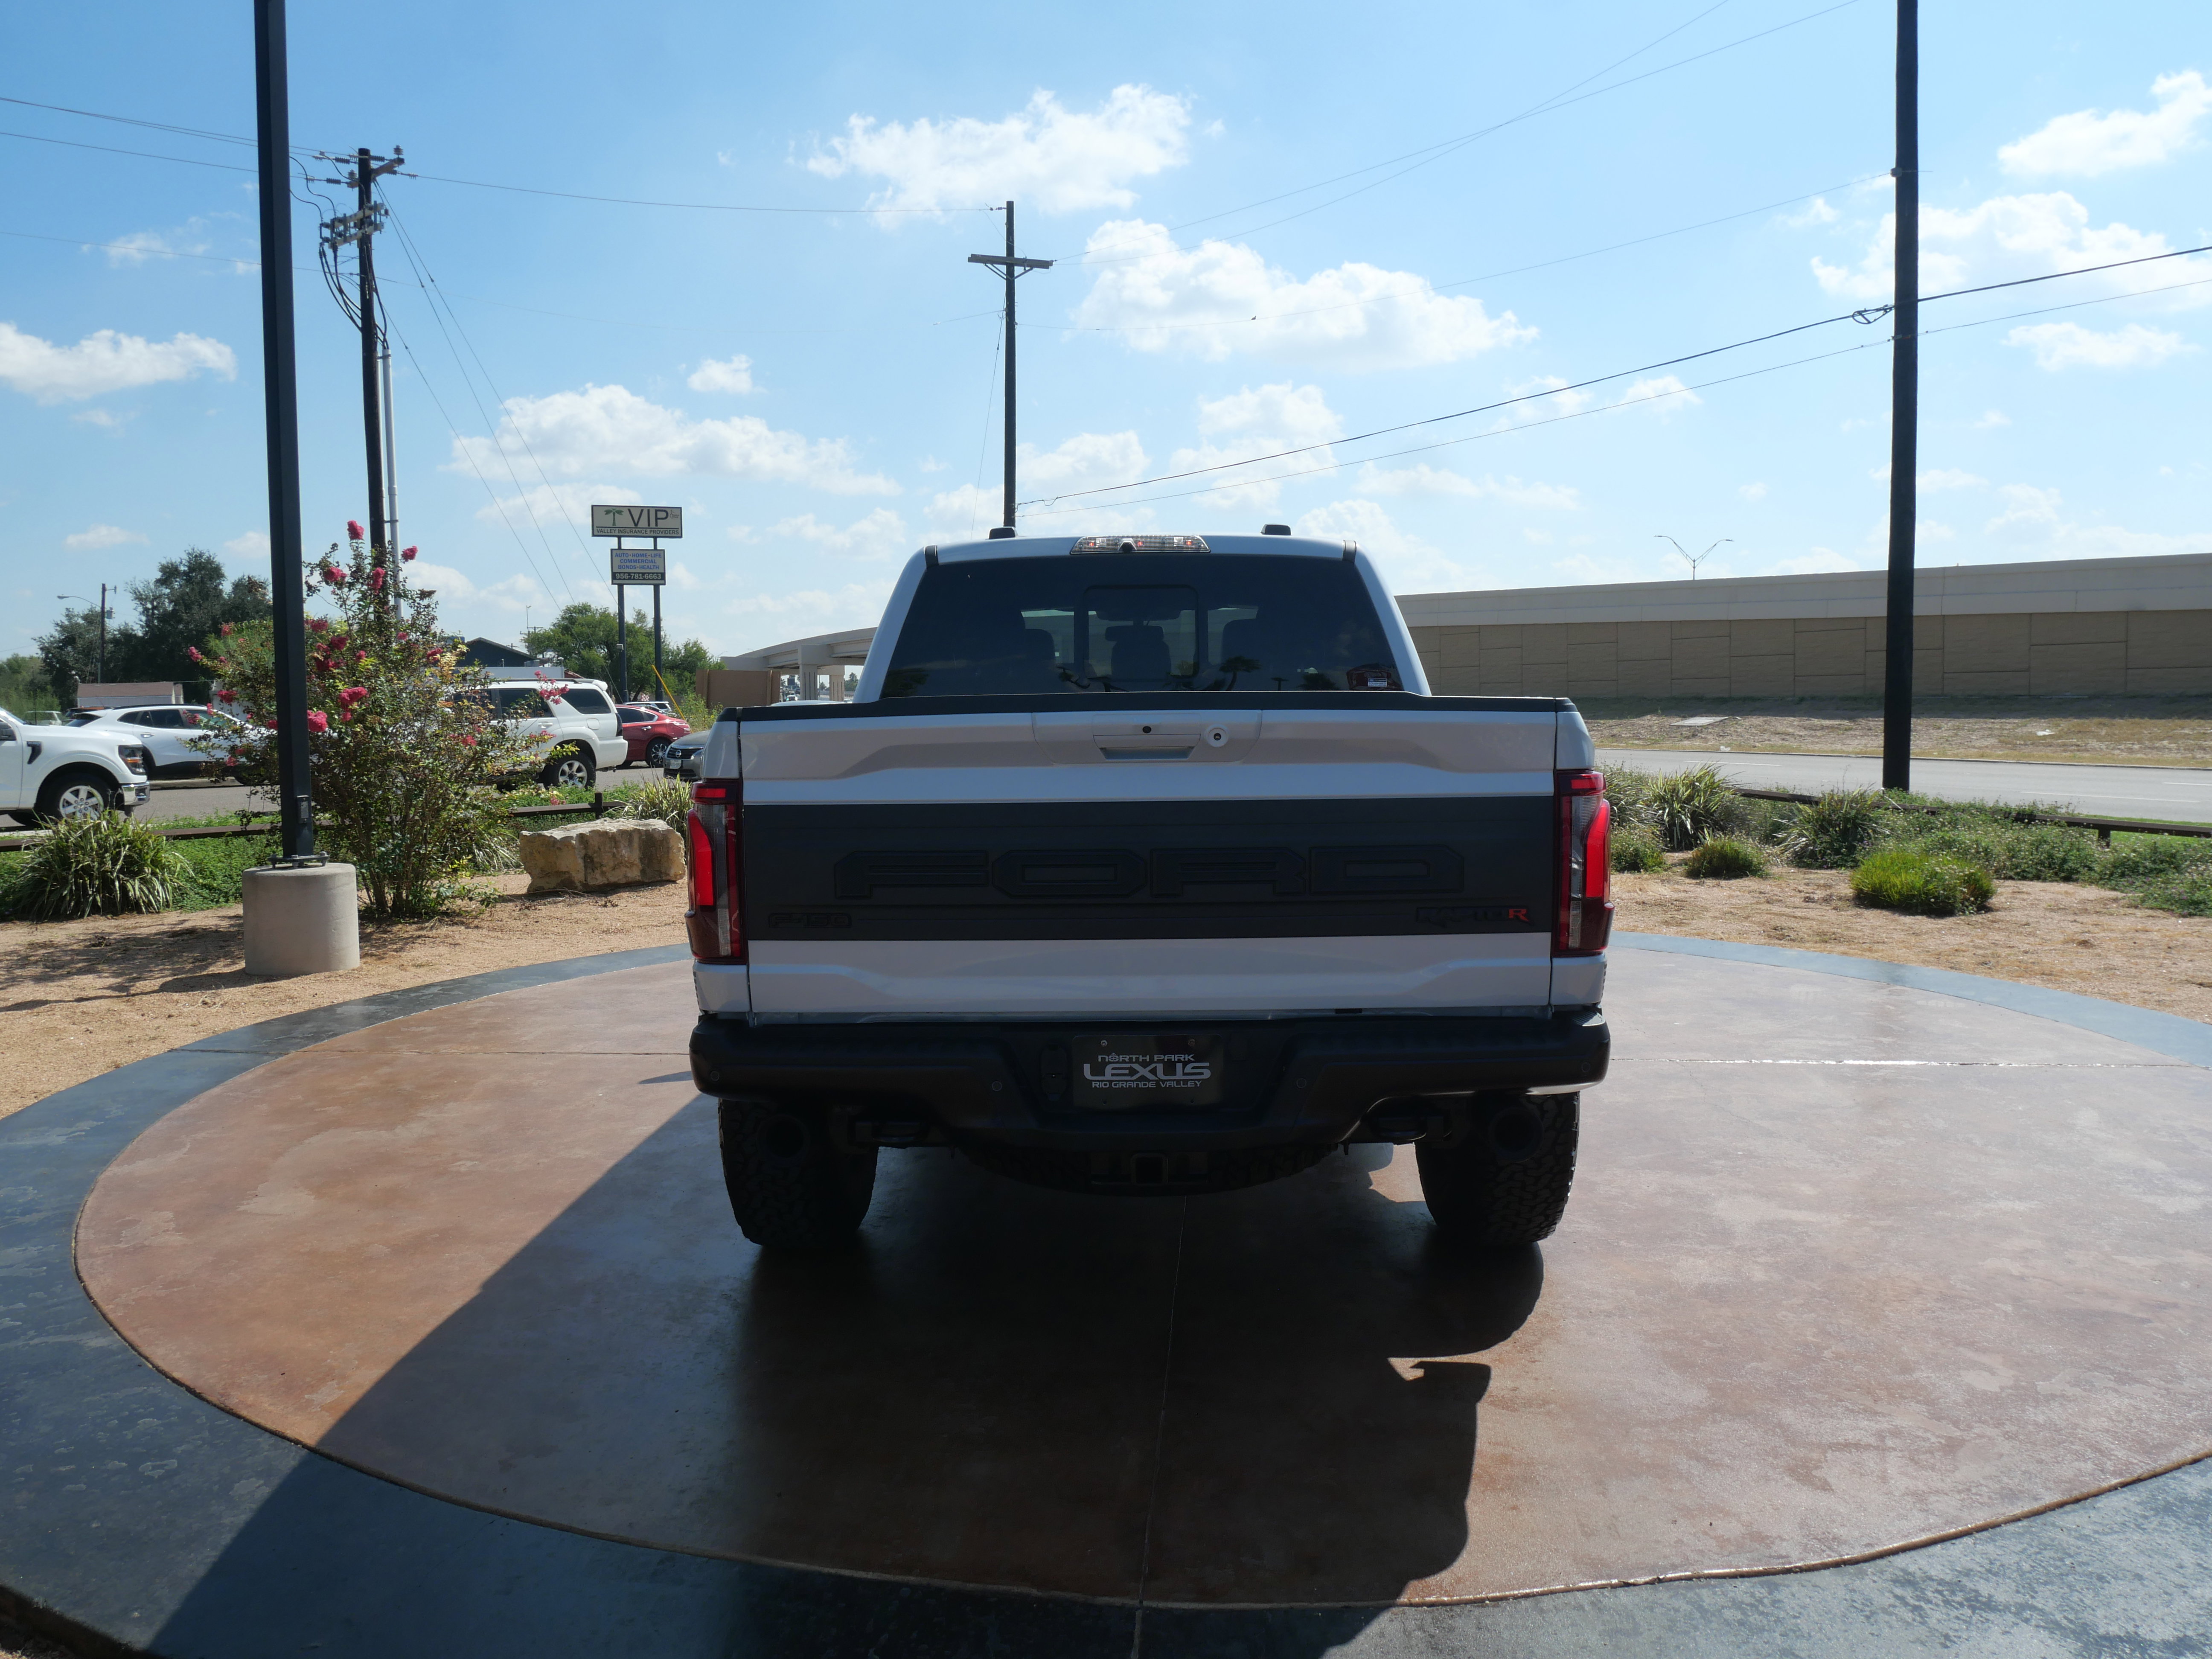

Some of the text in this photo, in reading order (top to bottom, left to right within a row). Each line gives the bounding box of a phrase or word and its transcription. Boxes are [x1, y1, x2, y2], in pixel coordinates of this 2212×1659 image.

[628, 508, 669, 527] VIP
[834, 844, 1464, 900] FORD
[1098, 1053, 1150, 1062] NORTH
[1083, 1062, 1211, 1080] LEXUS
